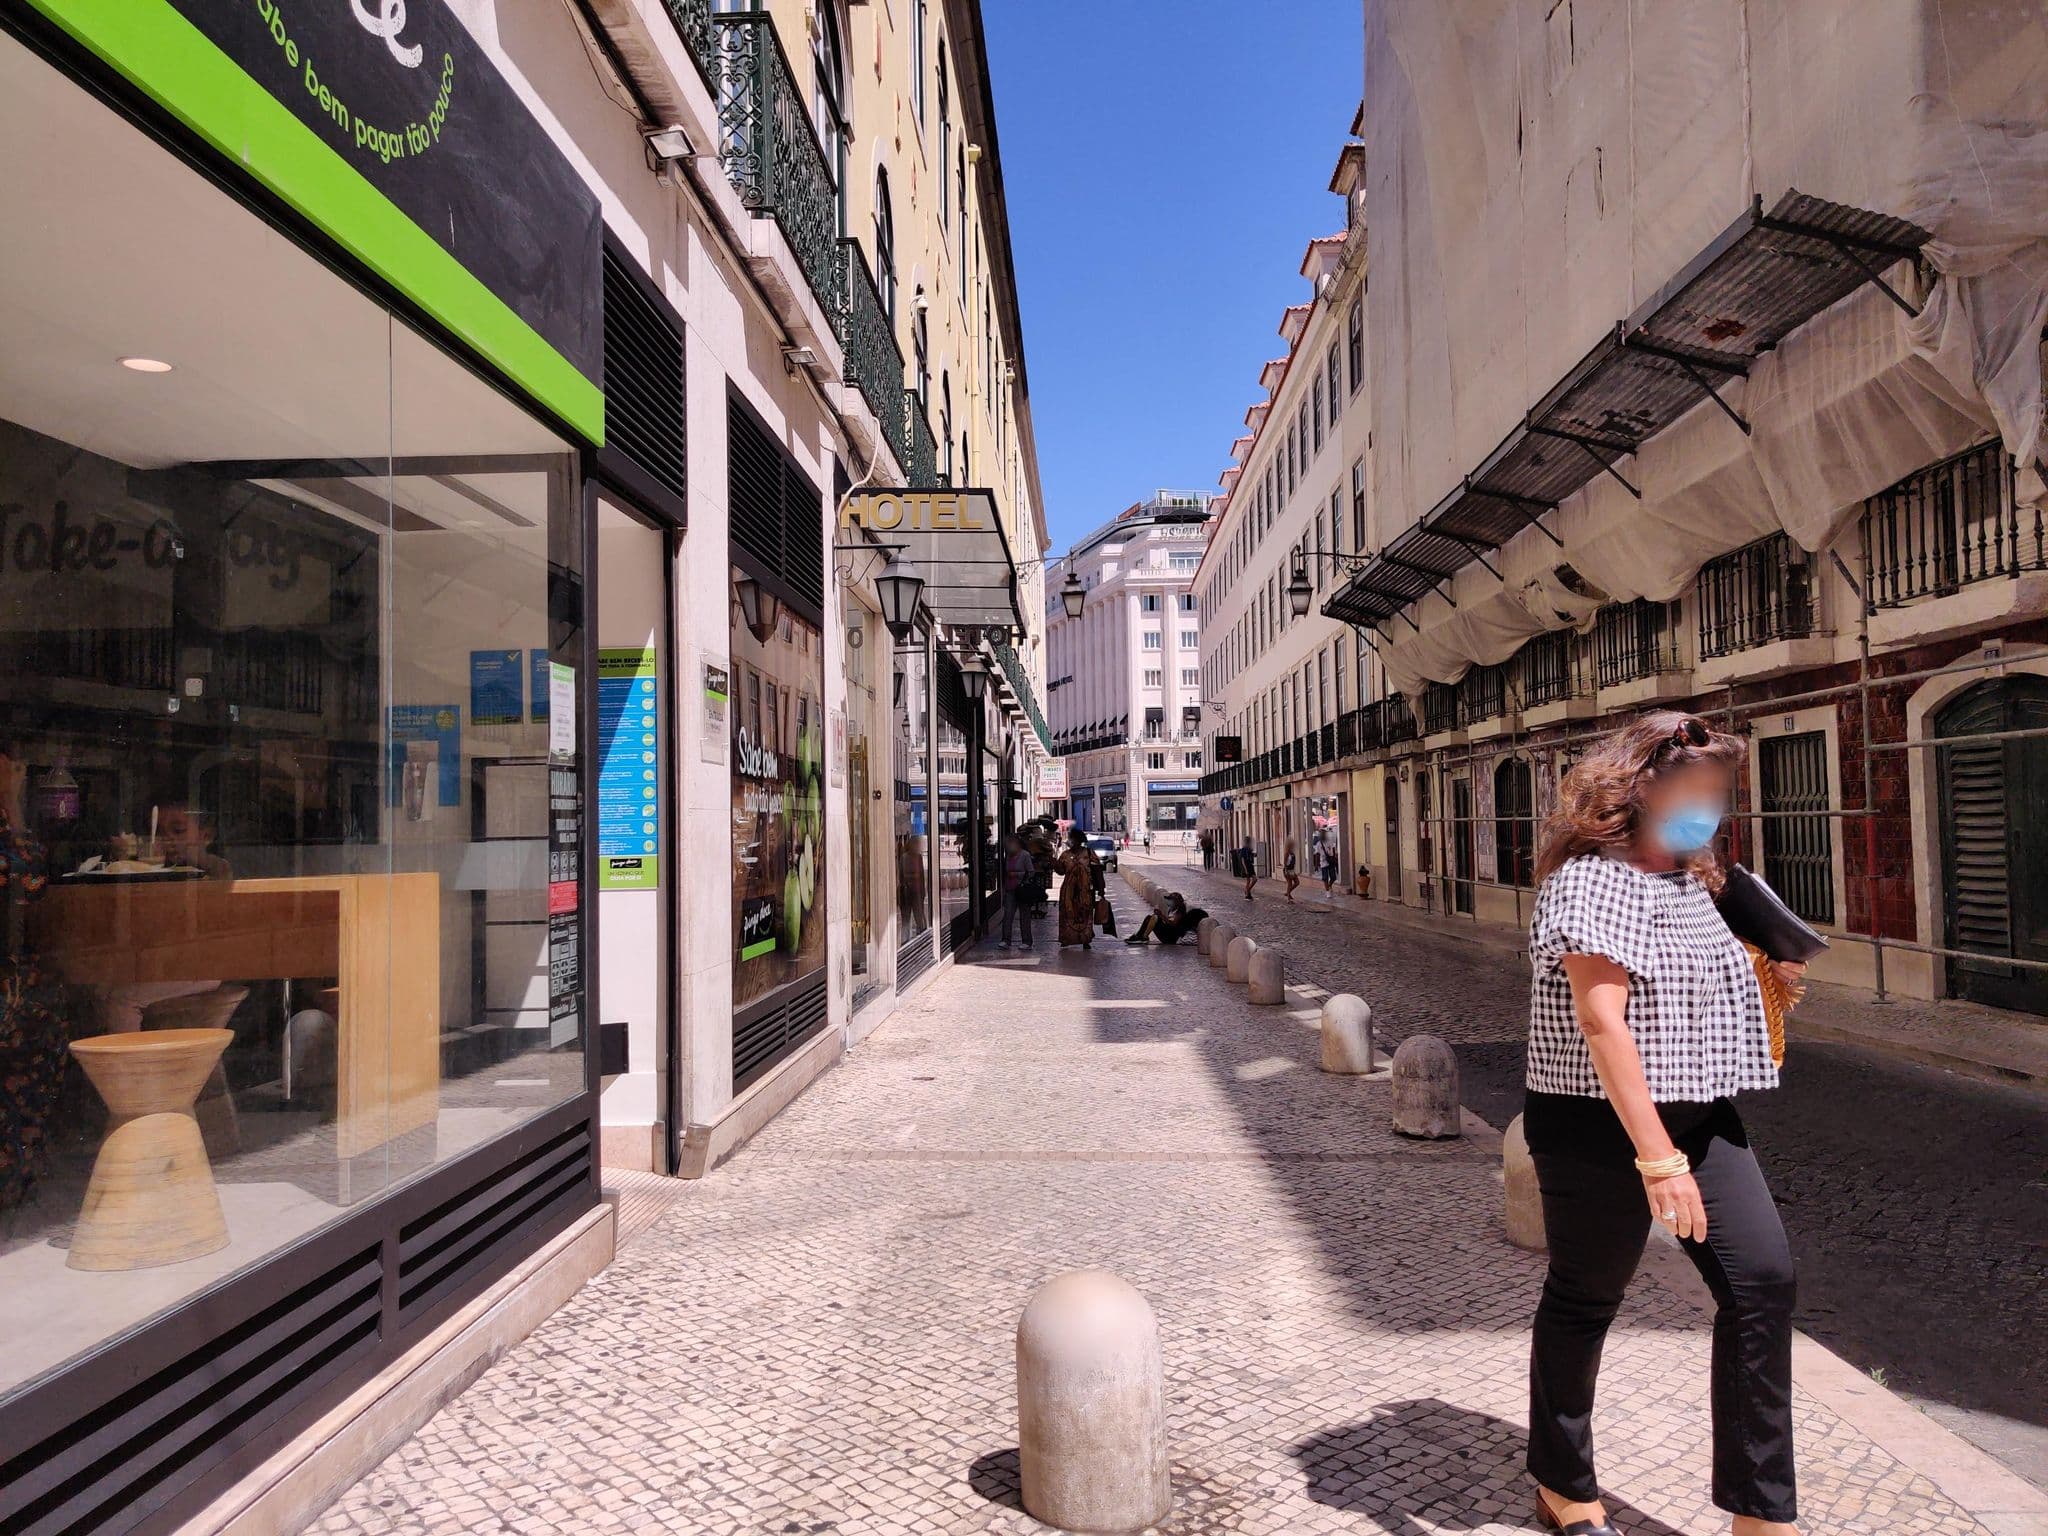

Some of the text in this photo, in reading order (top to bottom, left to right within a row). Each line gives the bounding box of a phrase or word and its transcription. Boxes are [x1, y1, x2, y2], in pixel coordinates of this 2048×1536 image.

[305, 57, 349, 133] bem
[354, 116, 405, 164] pagar
[406, 122, 430, 156] tão
[428, 52, 454, 144] pouco
[840, 493, 983, 530] HOTEL
[739, 726, 778, 780] Sabe bem
